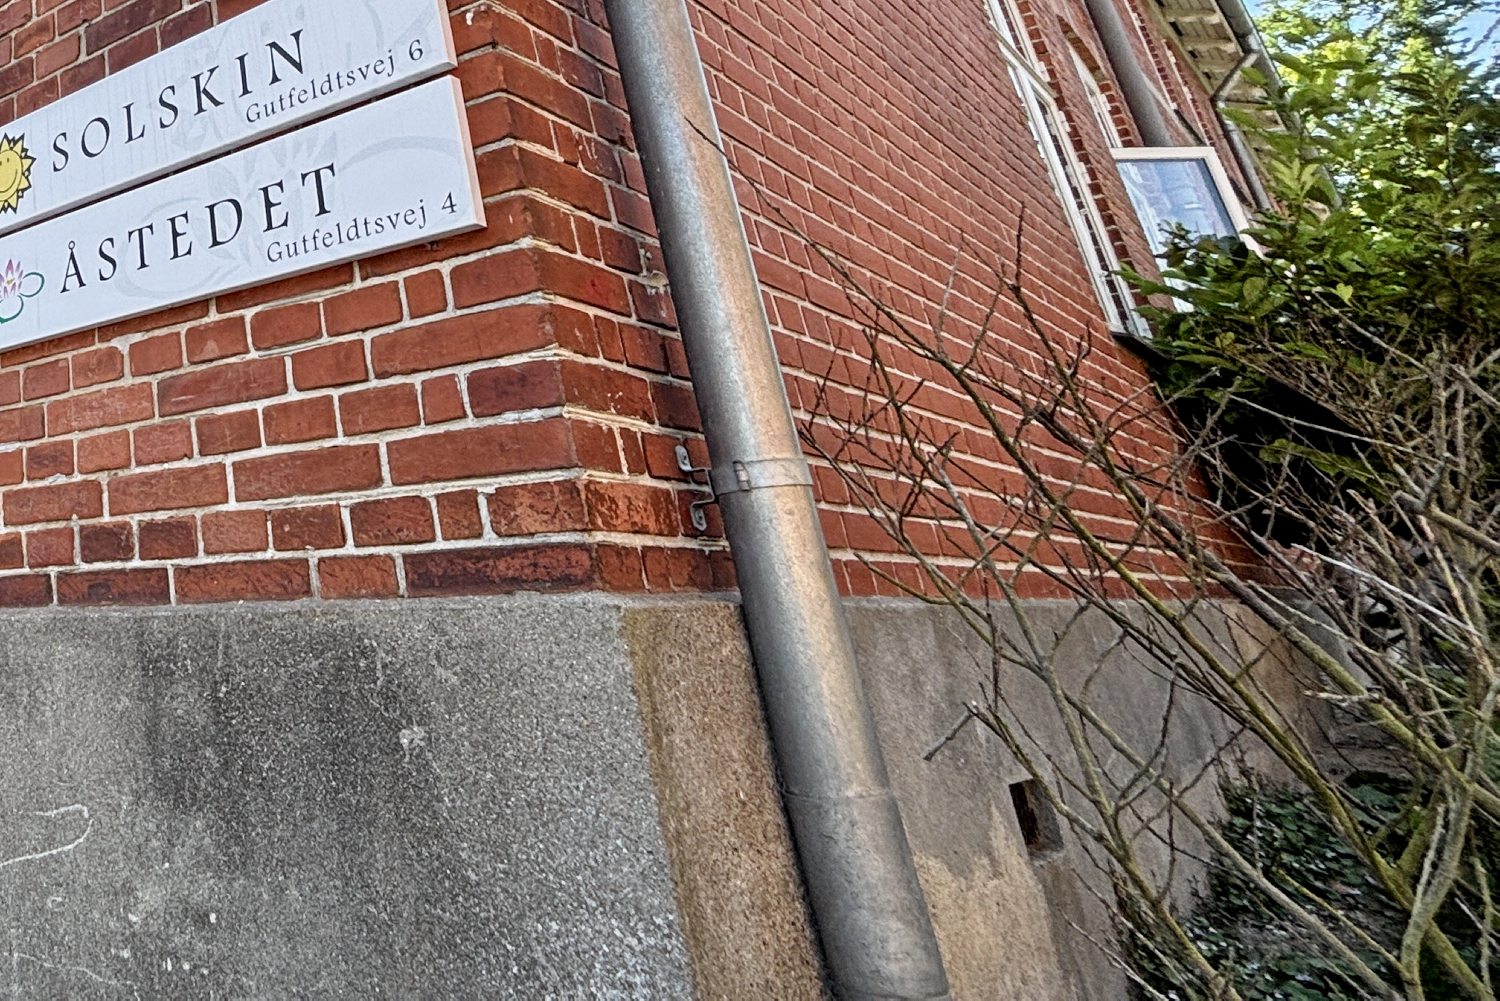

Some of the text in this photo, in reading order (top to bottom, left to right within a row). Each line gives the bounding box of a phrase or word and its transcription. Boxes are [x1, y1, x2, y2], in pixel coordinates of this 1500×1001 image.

[51, 29, 307, 173] SOLSKIN
[245, 39, 424, 124] Gutfeldtsvej 6
[59, 163, 337, 294] ÅSTEDET
[266, 191, 458, 263] Gutfeldtsvej 4
